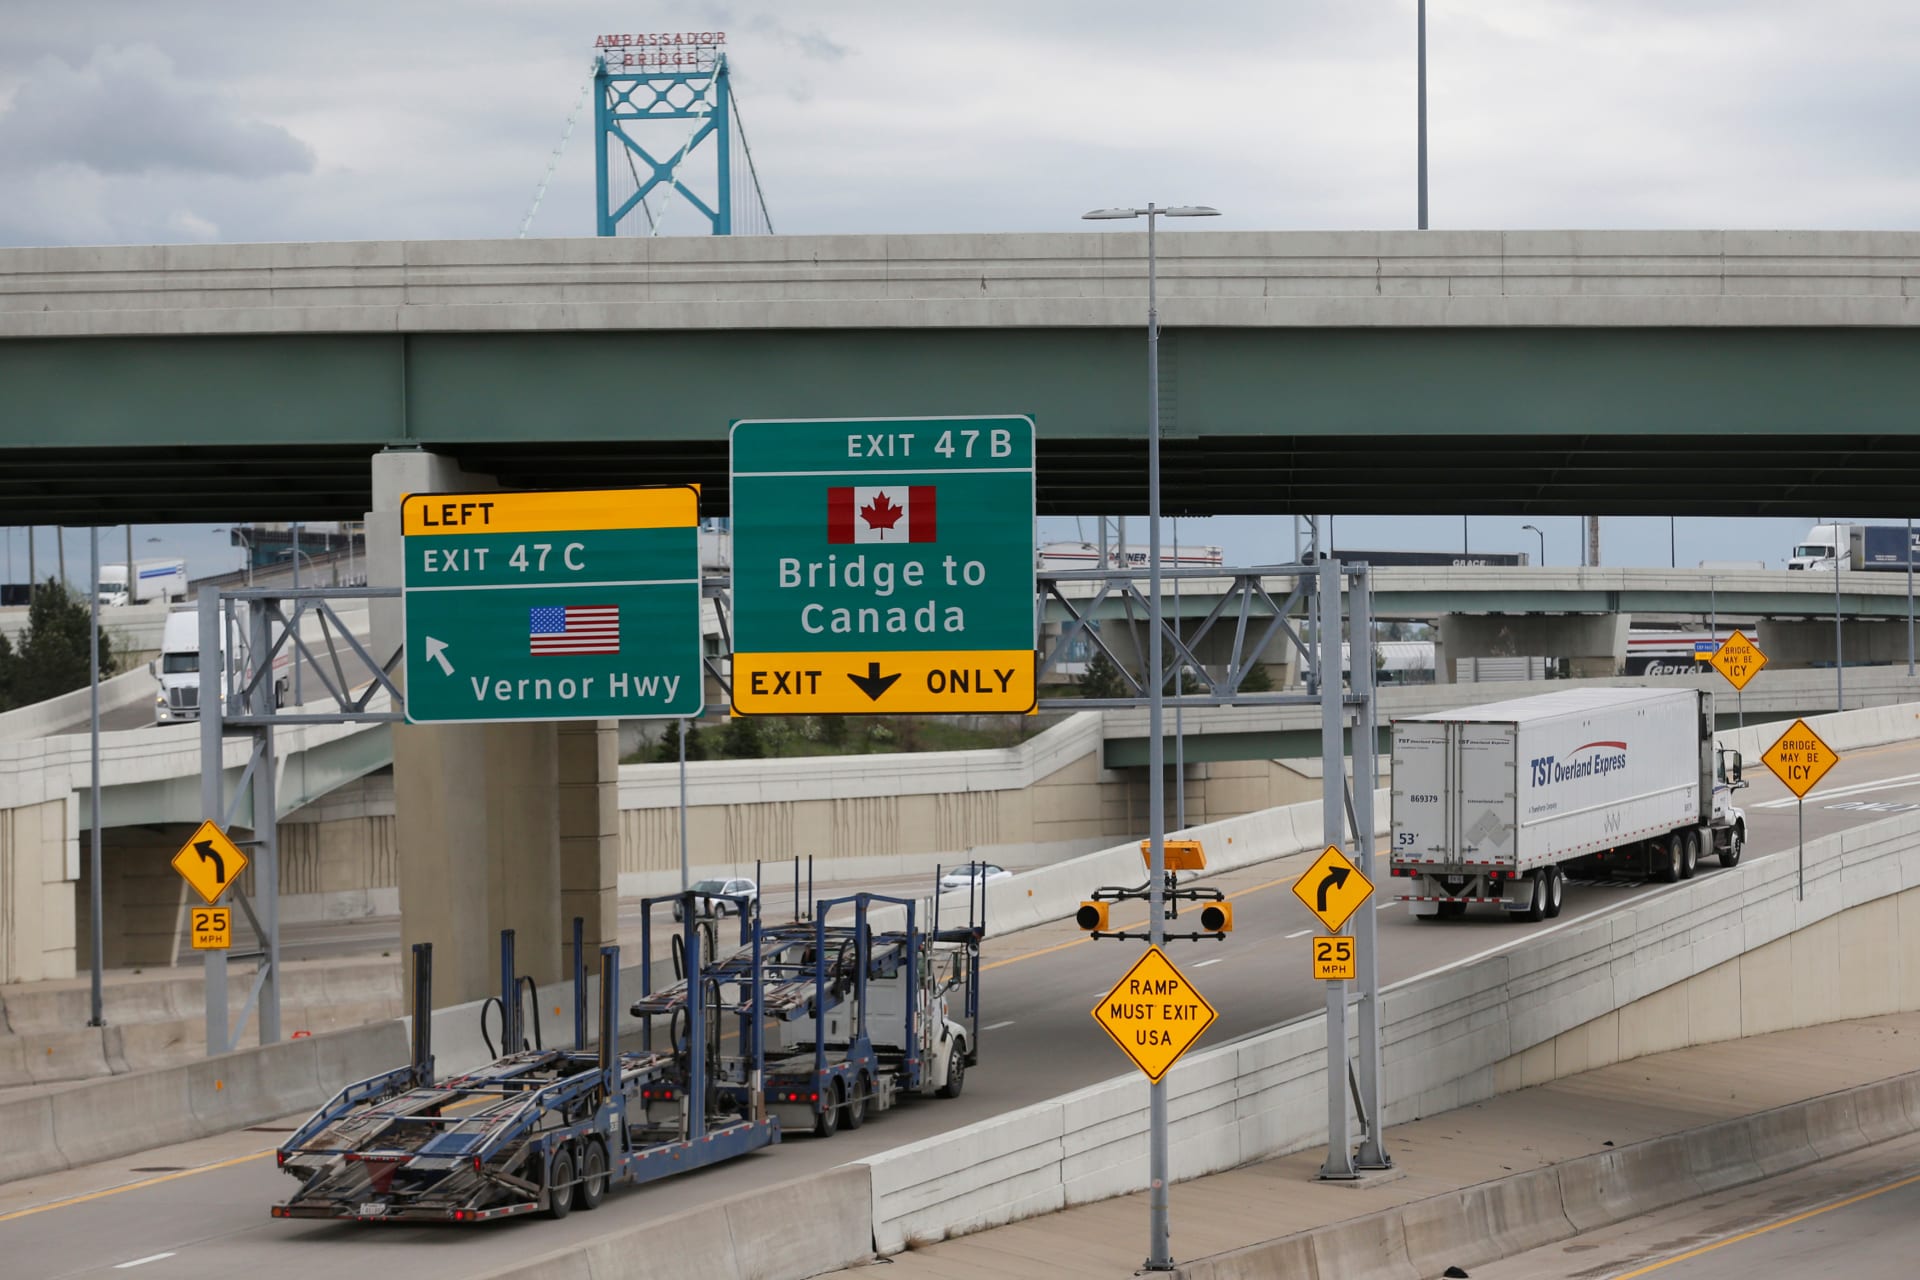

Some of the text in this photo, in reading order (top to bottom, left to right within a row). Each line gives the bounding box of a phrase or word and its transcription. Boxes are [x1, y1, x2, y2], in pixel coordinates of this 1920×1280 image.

[595, 32, 726, 46] AMBASSADOR
[624, 52, 697, 66] BRIDGE
[847, 433, 915, 458] EXIT
[423, 502, 495, 527] LEFT
[423, 548, 490, 573] EXIT
[779, 554, 986, 596] Bridge to
[801, 600, 965, 634] Canada
[1725, 646, 1751, 655] BRIDGE
[1723, 655, 1753, 664] MAY BE
[1730, 665, 1747, 677] ICY
[470, 672, 681, 704] Vernor Hwy
[751, 668, 1016, 695] EXIT ONLY
[1782, 740, 1817, 751] BRIDGE
[1780, 752, 1819, 763] MAY BE
[1530, 754, 1626, 788] TST Overland Express
[1788, 765, 1811, 780] ICY
[1410, 794, 1438, 803] 869379
[195, 913, 227, 932] 25
[200, 935, 223, 943] MPH
[1317, 942, 1351, 962] 25
[1322, 965, 1346, 974] MPH
[1130, 979, 1179, 996] RAMP
[1110, 1003, 1198, 1021] MUST EXIT
[1136, 1029, 1172, 1046] USA
